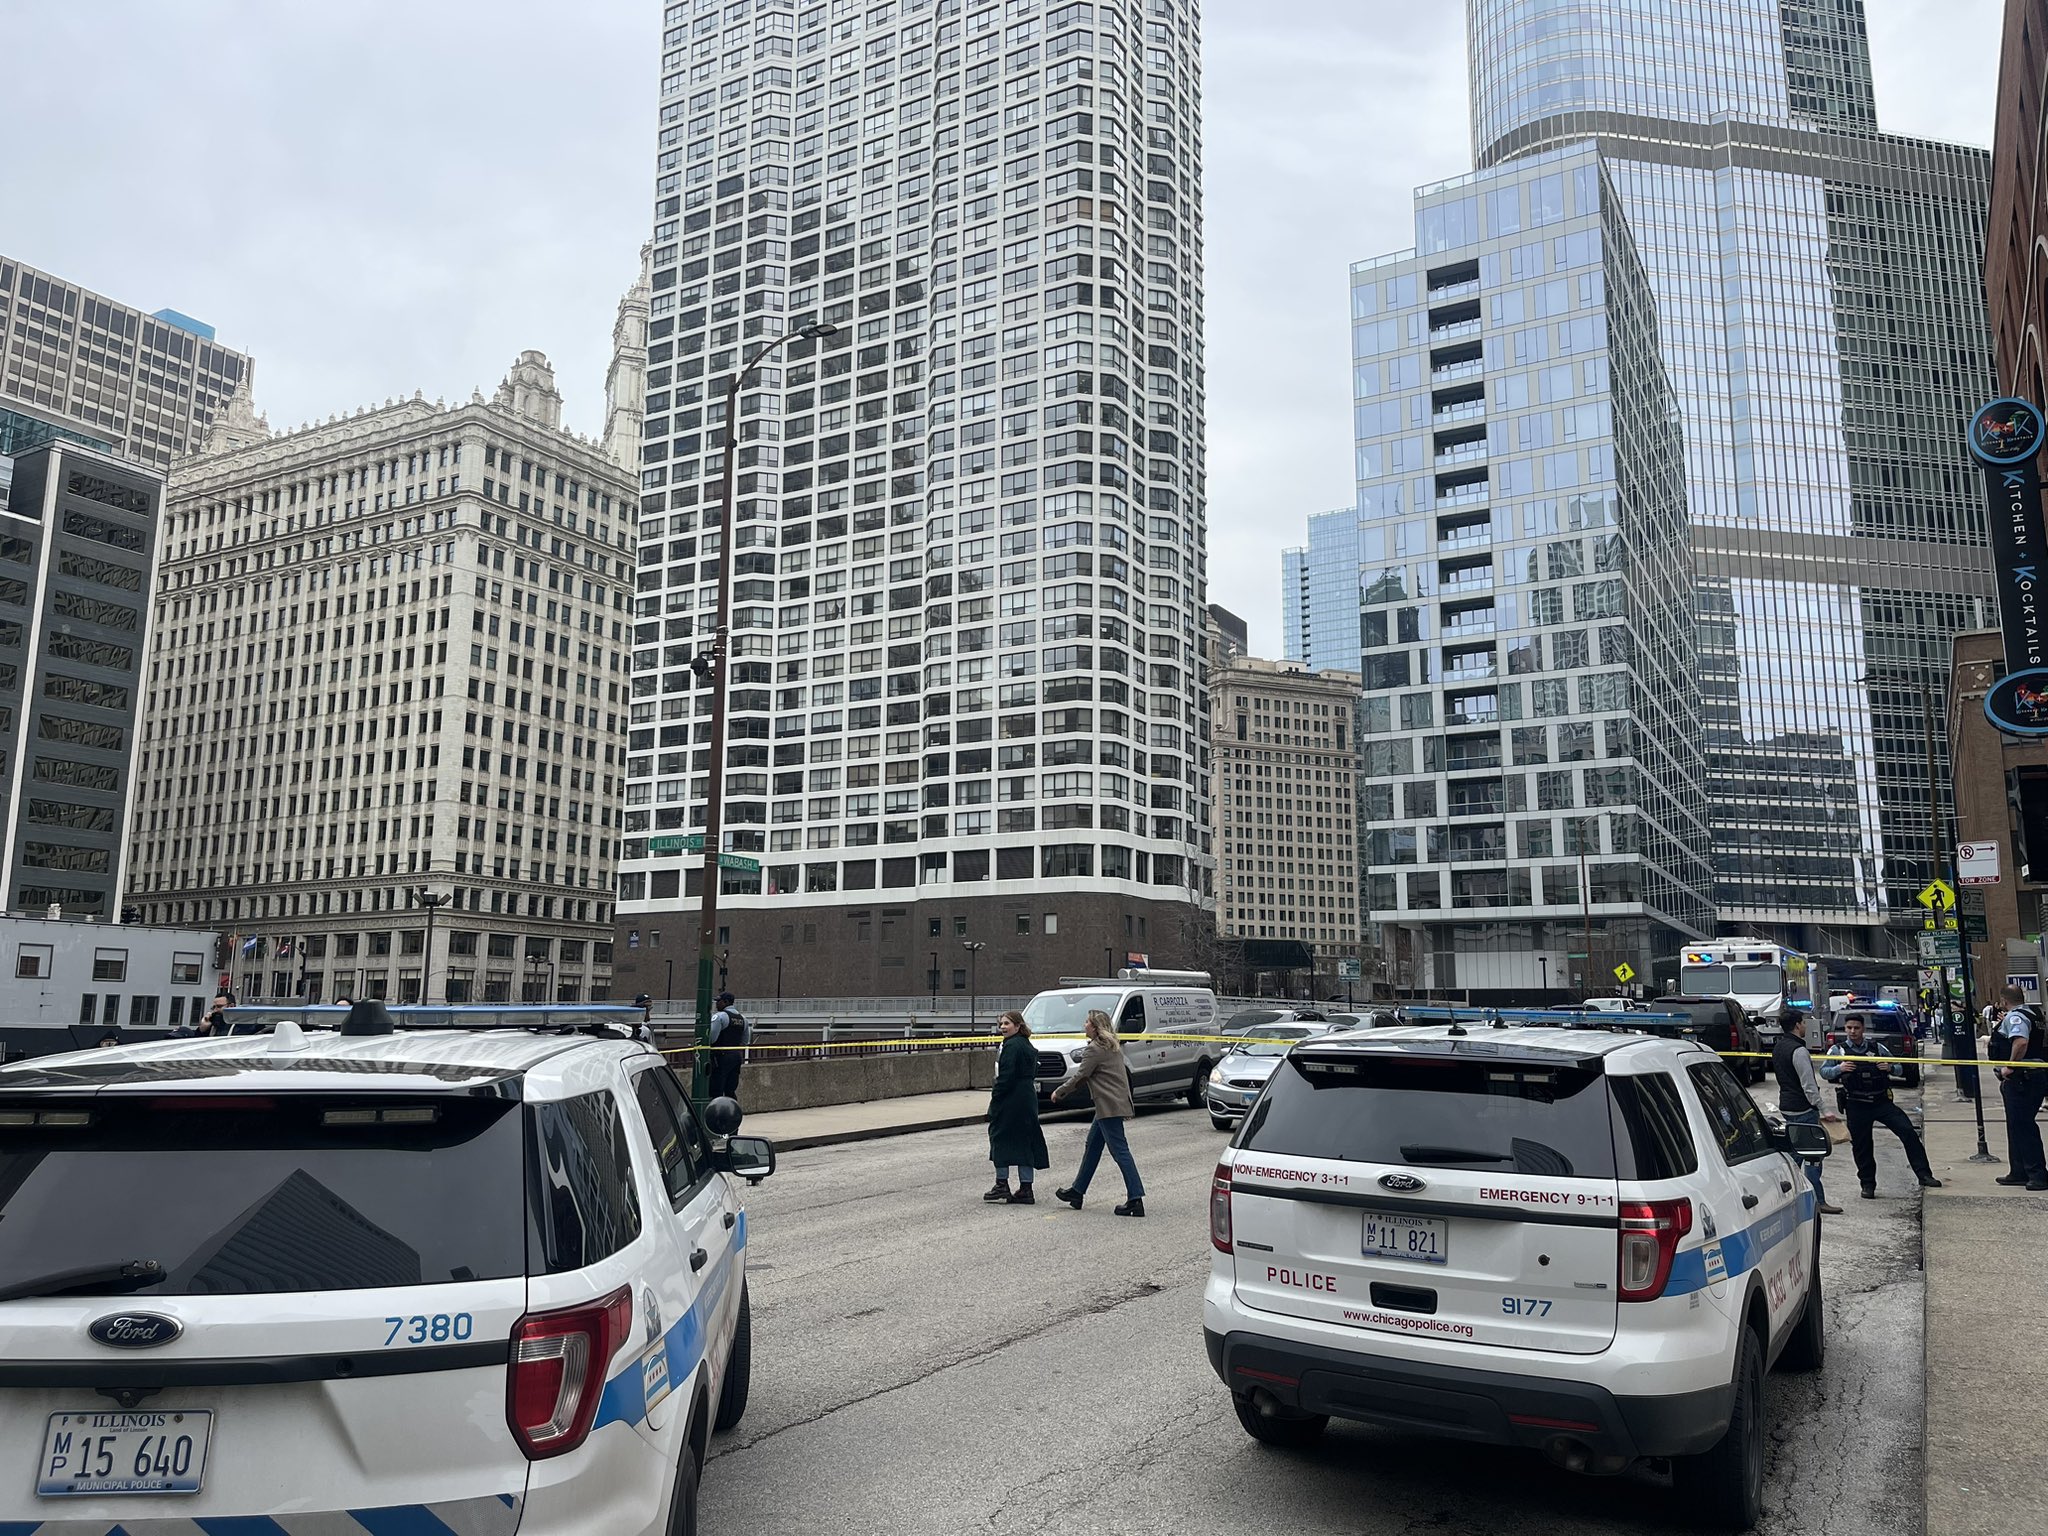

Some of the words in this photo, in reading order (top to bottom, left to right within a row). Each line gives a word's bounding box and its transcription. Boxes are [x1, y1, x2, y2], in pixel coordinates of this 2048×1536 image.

[2000, 469, 2027, 545] KITCHEN
[2012, 566, 2041, 664] KOCKTAILS
[657, 837, 695, 849] ILLINOIS
[723, 855, 753, 870] WABASH
[1234, 1163, 1316, 1183] NON-EMERGENCY
[1321, 1173, 1349, 1186] 3-1-1
[1386, 1173, 1415, 1190] Ford
[1479, 1187, 1570, 1205] EMERGENCY
[1577, 1194, 1614, 1207] 9-1-1
[1385, 1216, 1423, 1227] ILLINOIS
[1379, 1227, 1397, 1249] 11
[1408, 1230, 1438, 1254] 821
[1267, 1266, 1337, 1292] POLICE
[1502, 1297, 1553, 1317] 9177
[106, 1317, 158, 1340] Ford
[384, 1312, 473, 1346] 7380
[1343, 1309, 1473, 1338] www.chicagopolice.org
[92, 1414, 166, 1428] ILLINOIS
[74, 1435, 117, 1478] 15
[134, 1435, 193, 1477] 640
[76, 1481, 128, 1490] MUNICIPAL
[130, 1479, 162, 1489] POLICE
